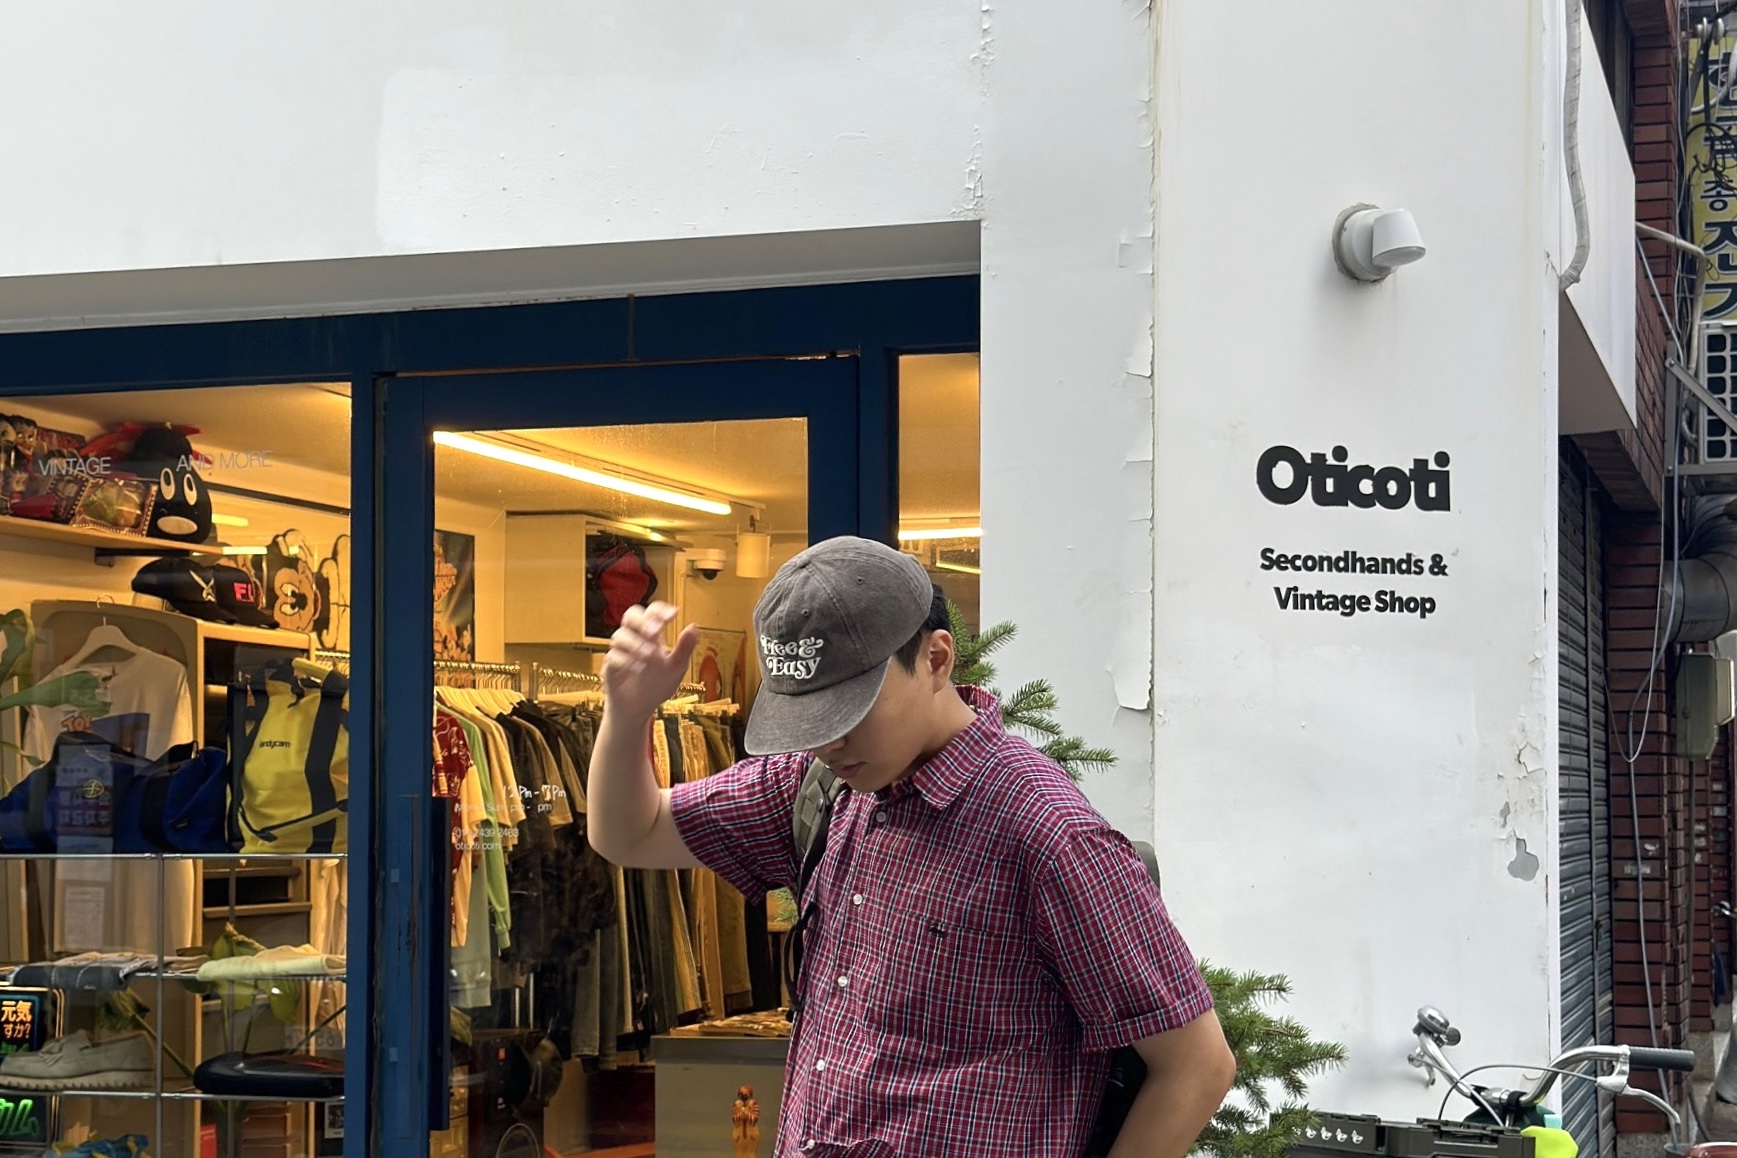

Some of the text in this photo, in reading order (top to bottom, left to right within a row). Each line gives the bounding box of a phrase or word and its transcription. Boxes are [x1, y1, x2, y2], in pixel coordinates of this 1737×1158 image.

[38, 448, 274, 477] VINTAGE AND MORE
[1256, 445, 1451, 512] Oticoti
[1260, 547, 1449, 577] Secondhands &
[1273, 586, 1436, 619] Vintage Shop
[766, 656, 821, 679] Easy
[1, 1000, 33, 1022] 元気
